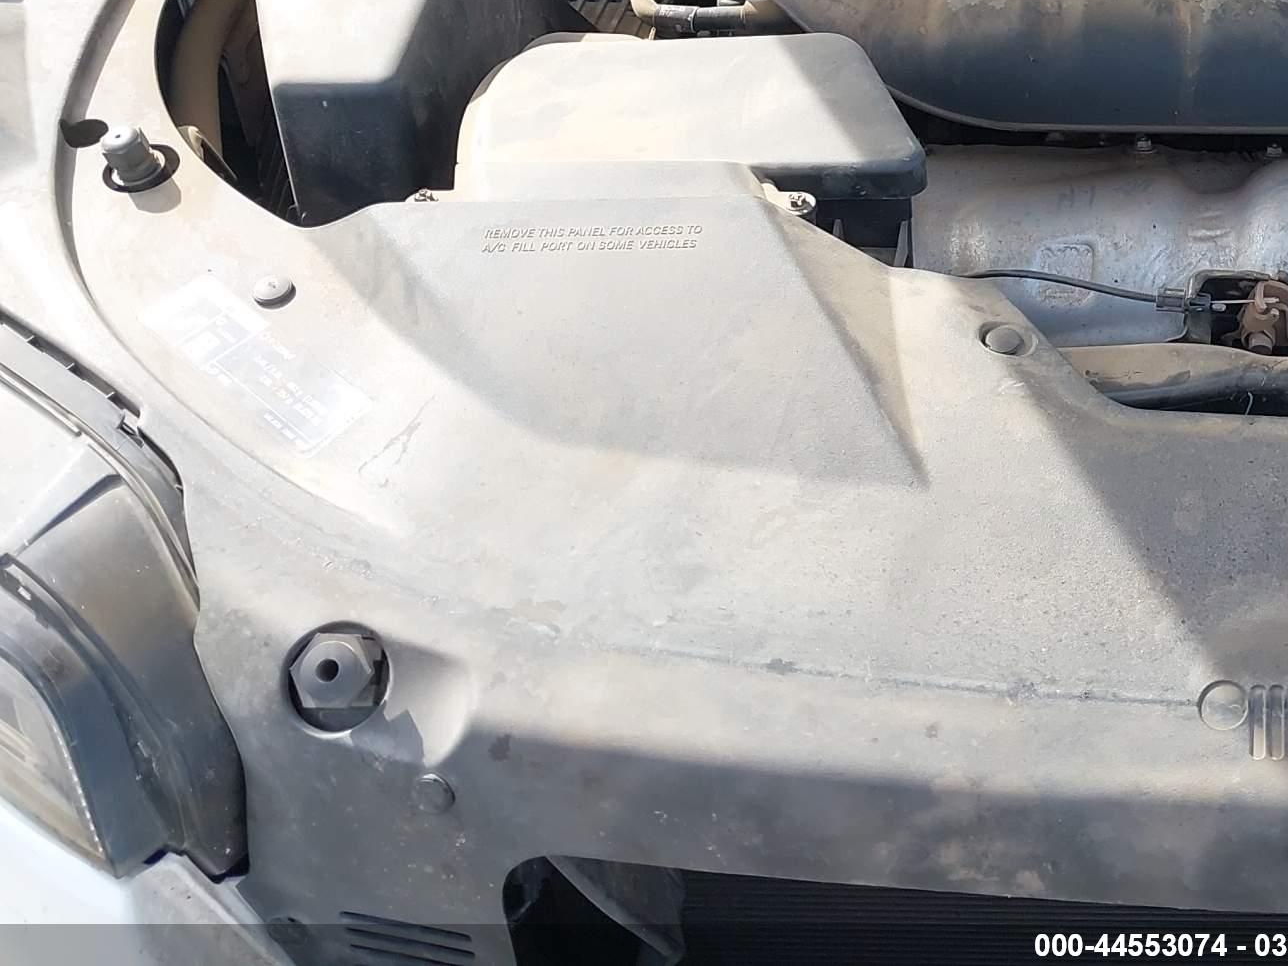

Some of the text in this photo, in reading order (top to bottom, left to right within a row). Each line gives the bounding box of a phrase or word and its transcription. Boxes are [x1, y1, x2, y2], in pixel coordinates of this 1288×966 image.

[484, 225, 703, 239] REMOVE THIS PANEL FOR ACCESS TO
[481, 238, 698, 253] A/C FILL PORT ON SOME VEHICLES
